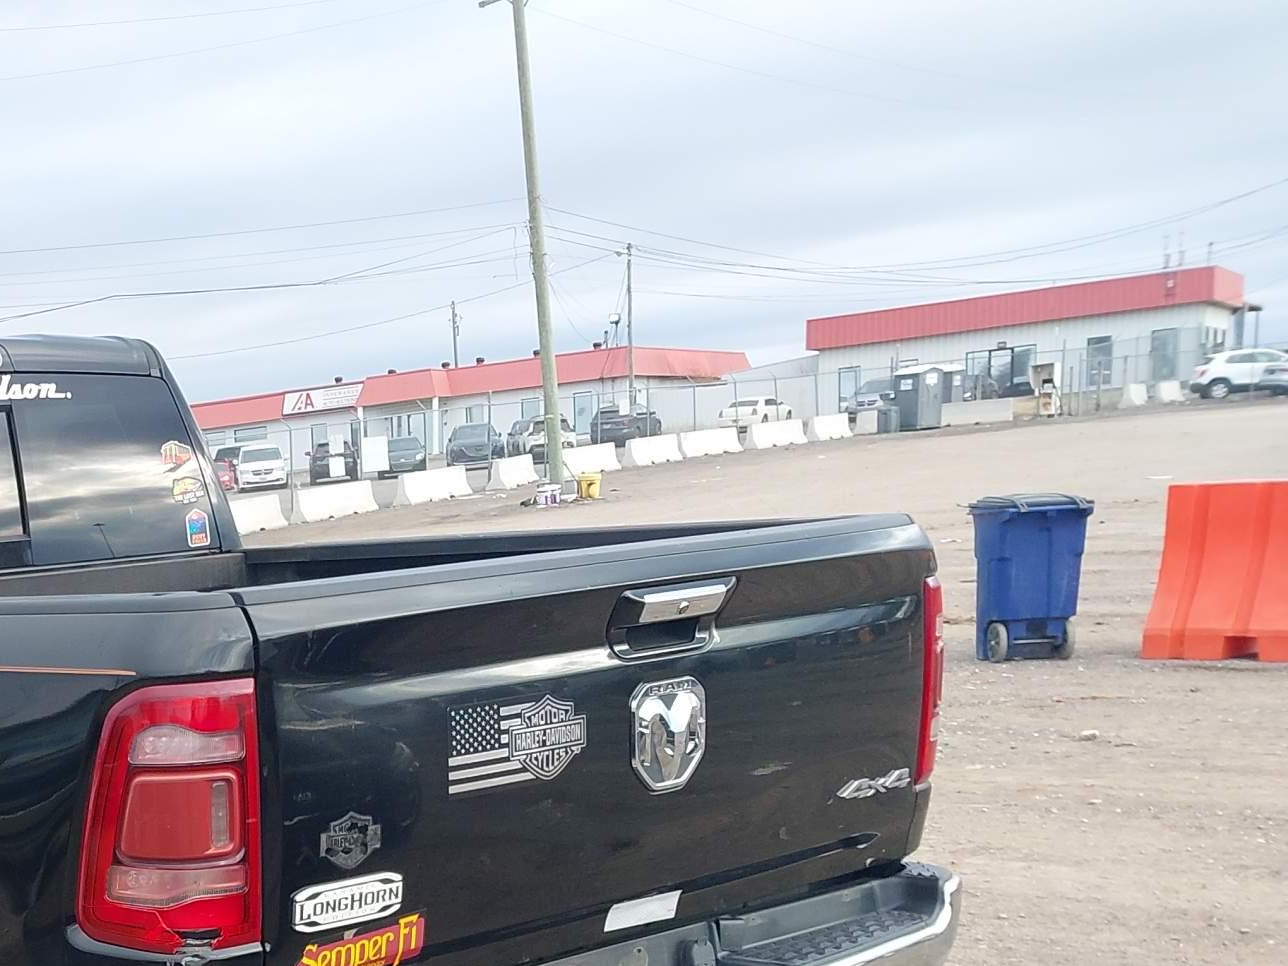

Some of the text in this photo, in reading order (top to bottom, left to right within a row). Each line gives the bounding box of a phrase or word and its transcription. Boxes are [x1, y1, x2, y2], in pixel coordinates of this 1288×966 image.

[649, 680, 692, 696] RAM
[530, 710, 567, 727] MOTOR
[515, 723, 582, 751] HARLEY-DAVIDSON
[531, 750, 565, 773] CYCLES
